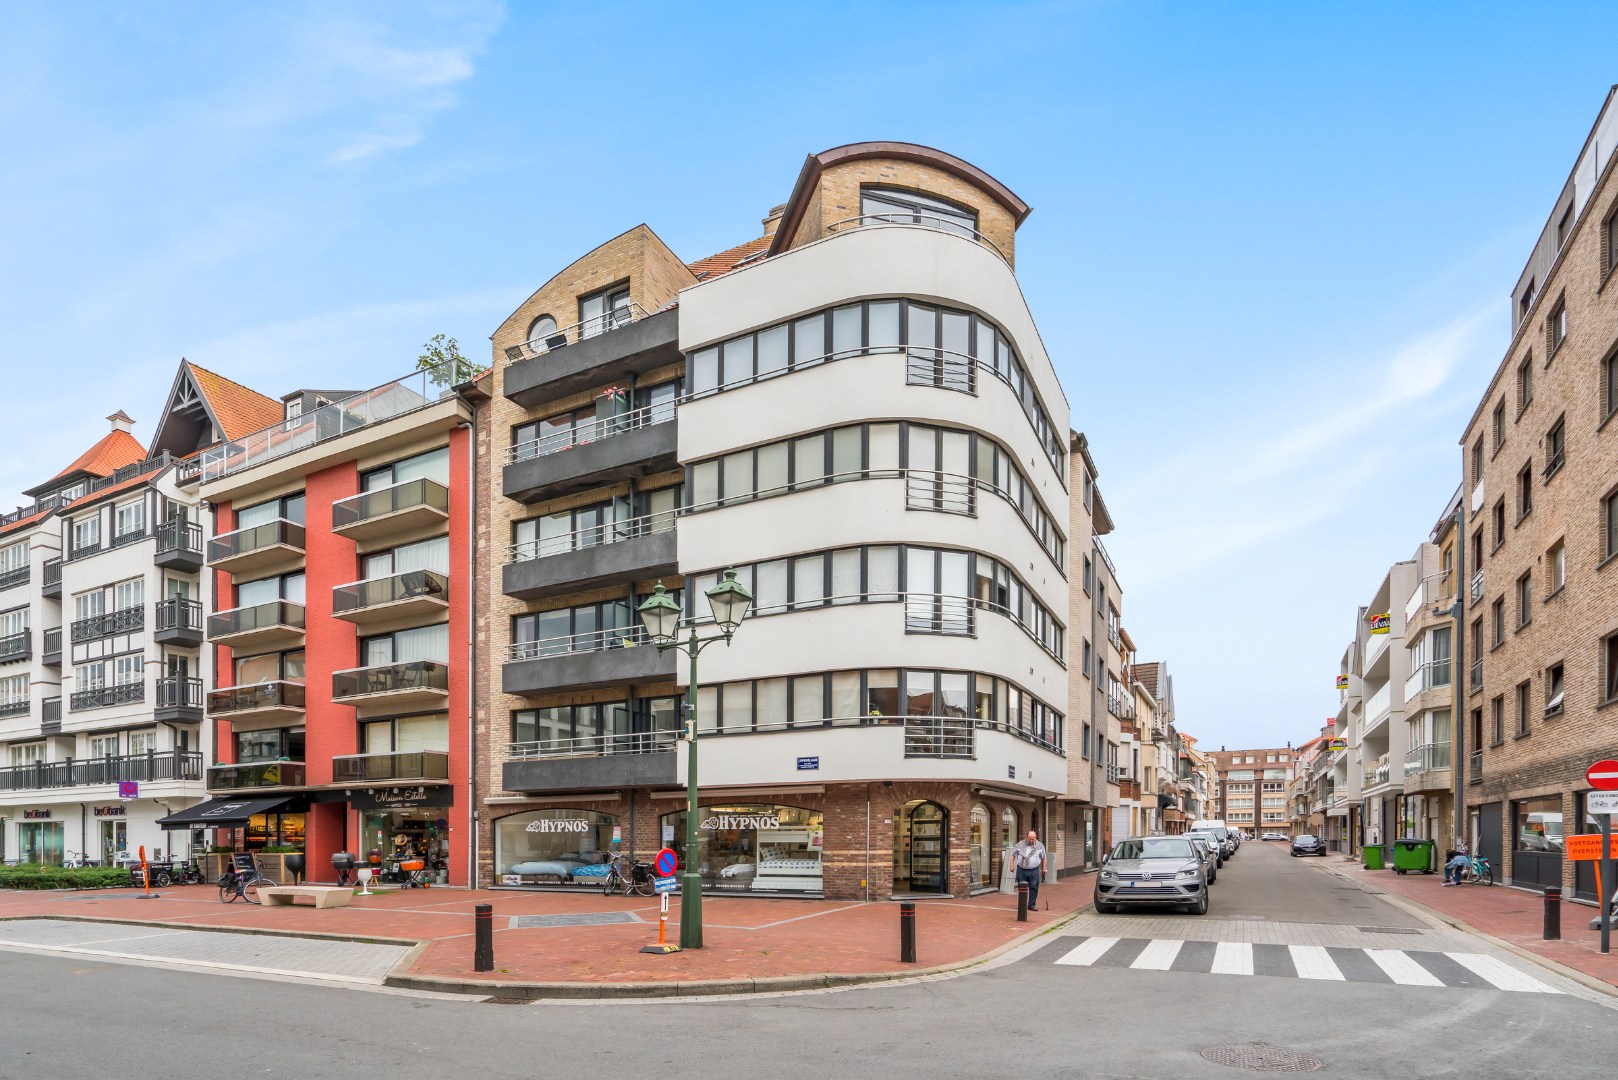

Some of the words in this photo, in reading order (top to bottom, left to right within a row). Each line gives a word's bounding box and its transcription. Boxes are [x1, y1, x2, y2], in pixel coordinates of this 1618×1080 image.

[375, 791, 403, 802] Maison
[540, 819, 589, 832] HYPNOS
[719, 814, 780, 830] HYPNOS
